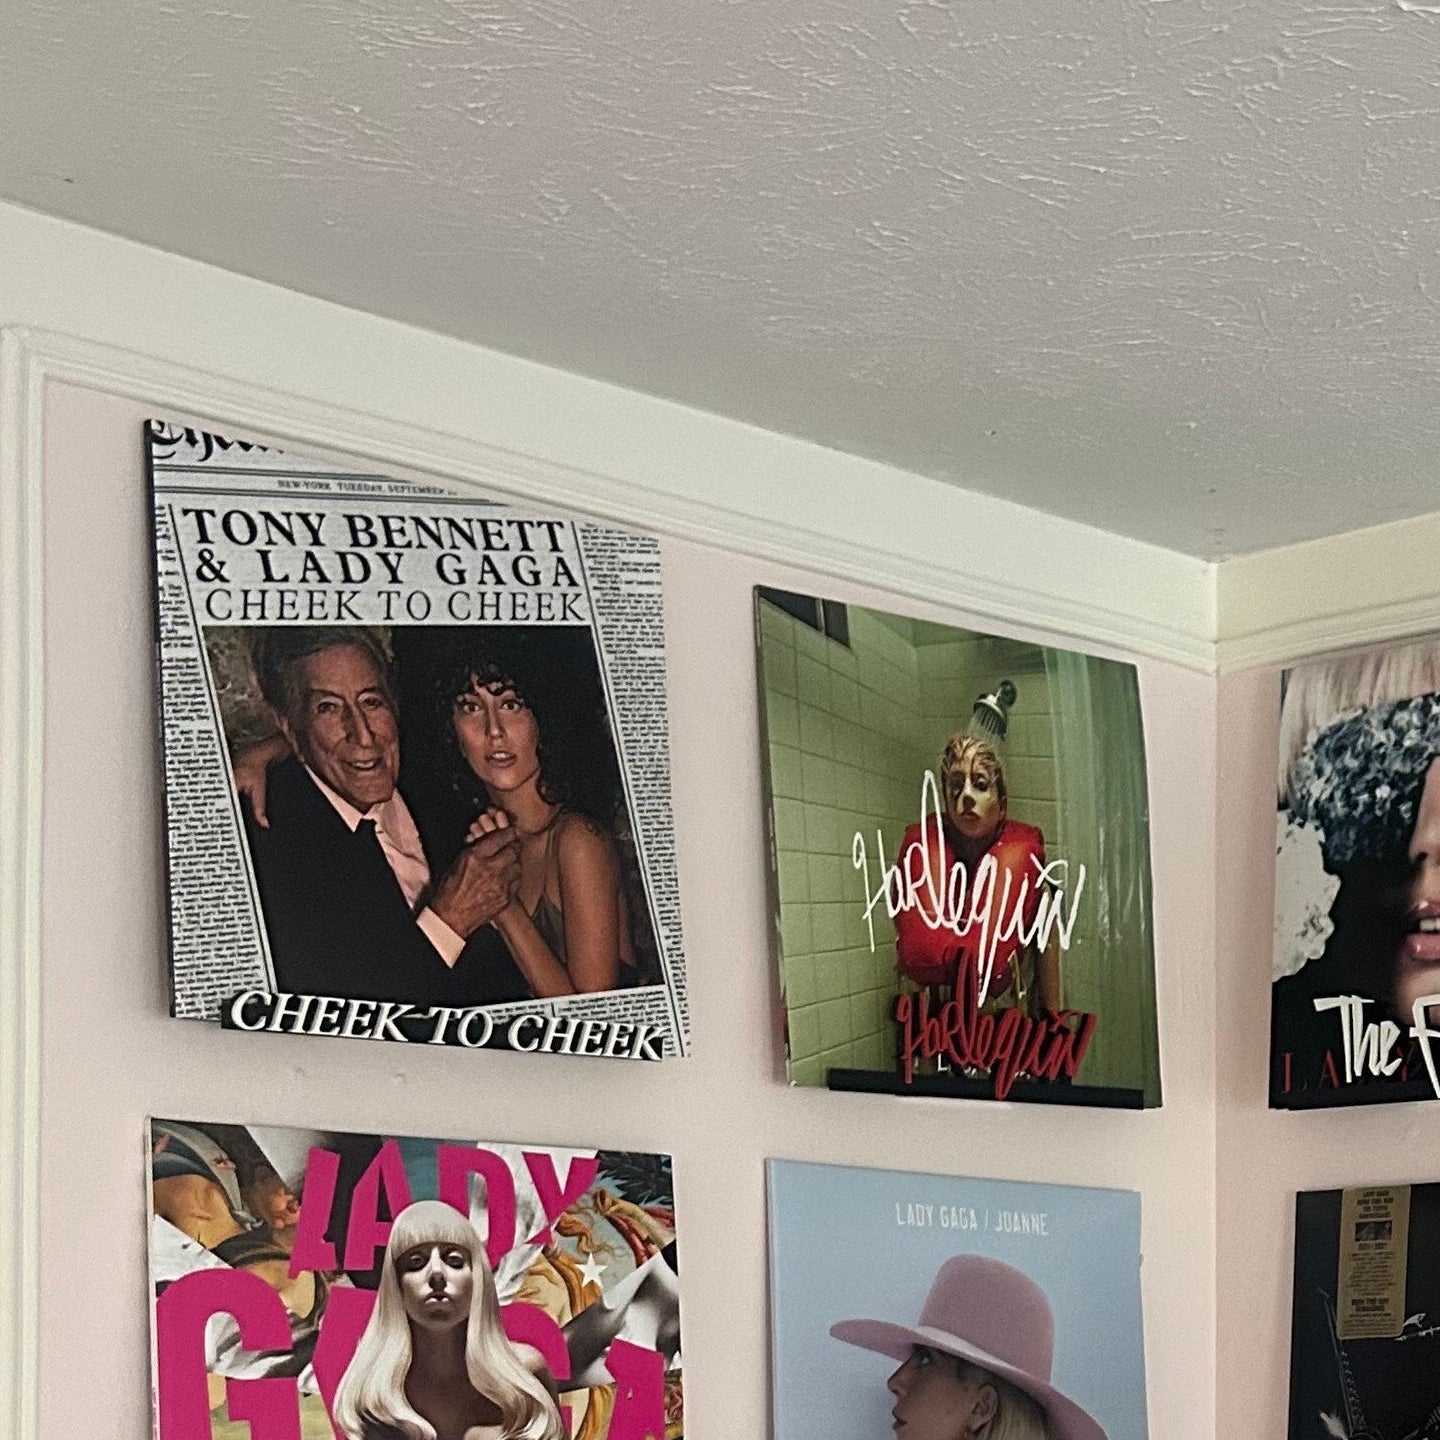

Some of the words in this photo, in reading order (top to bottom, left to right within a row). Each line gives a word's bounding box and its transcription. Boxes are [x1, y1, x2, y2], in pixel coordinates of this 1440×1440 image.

[183, 509, 327, 547] TONY
[343, 514, 564, 553] BENNETT
[196, 548, 230, 583] &
[256, 549, 404, 584] LADY
[436, 552, 580, 587] GAGA
[205, 588, 364, 621] CHEEK
[377, 590, 432, 621] TO
[448, 591, 586, 622] CHEEK
[230, 989, 413, 1043] CHEEK
[421, 1006, 493, 1048] TO
[507, 1014, 671, 1062] CHEEK
[1313, 994, 1403, 1083] The
[896, 1202, 933, 1227] LADY
[940, 1205, 978, 1231] GAGA
[995, 1210, 1049, 1236] JOANNE
